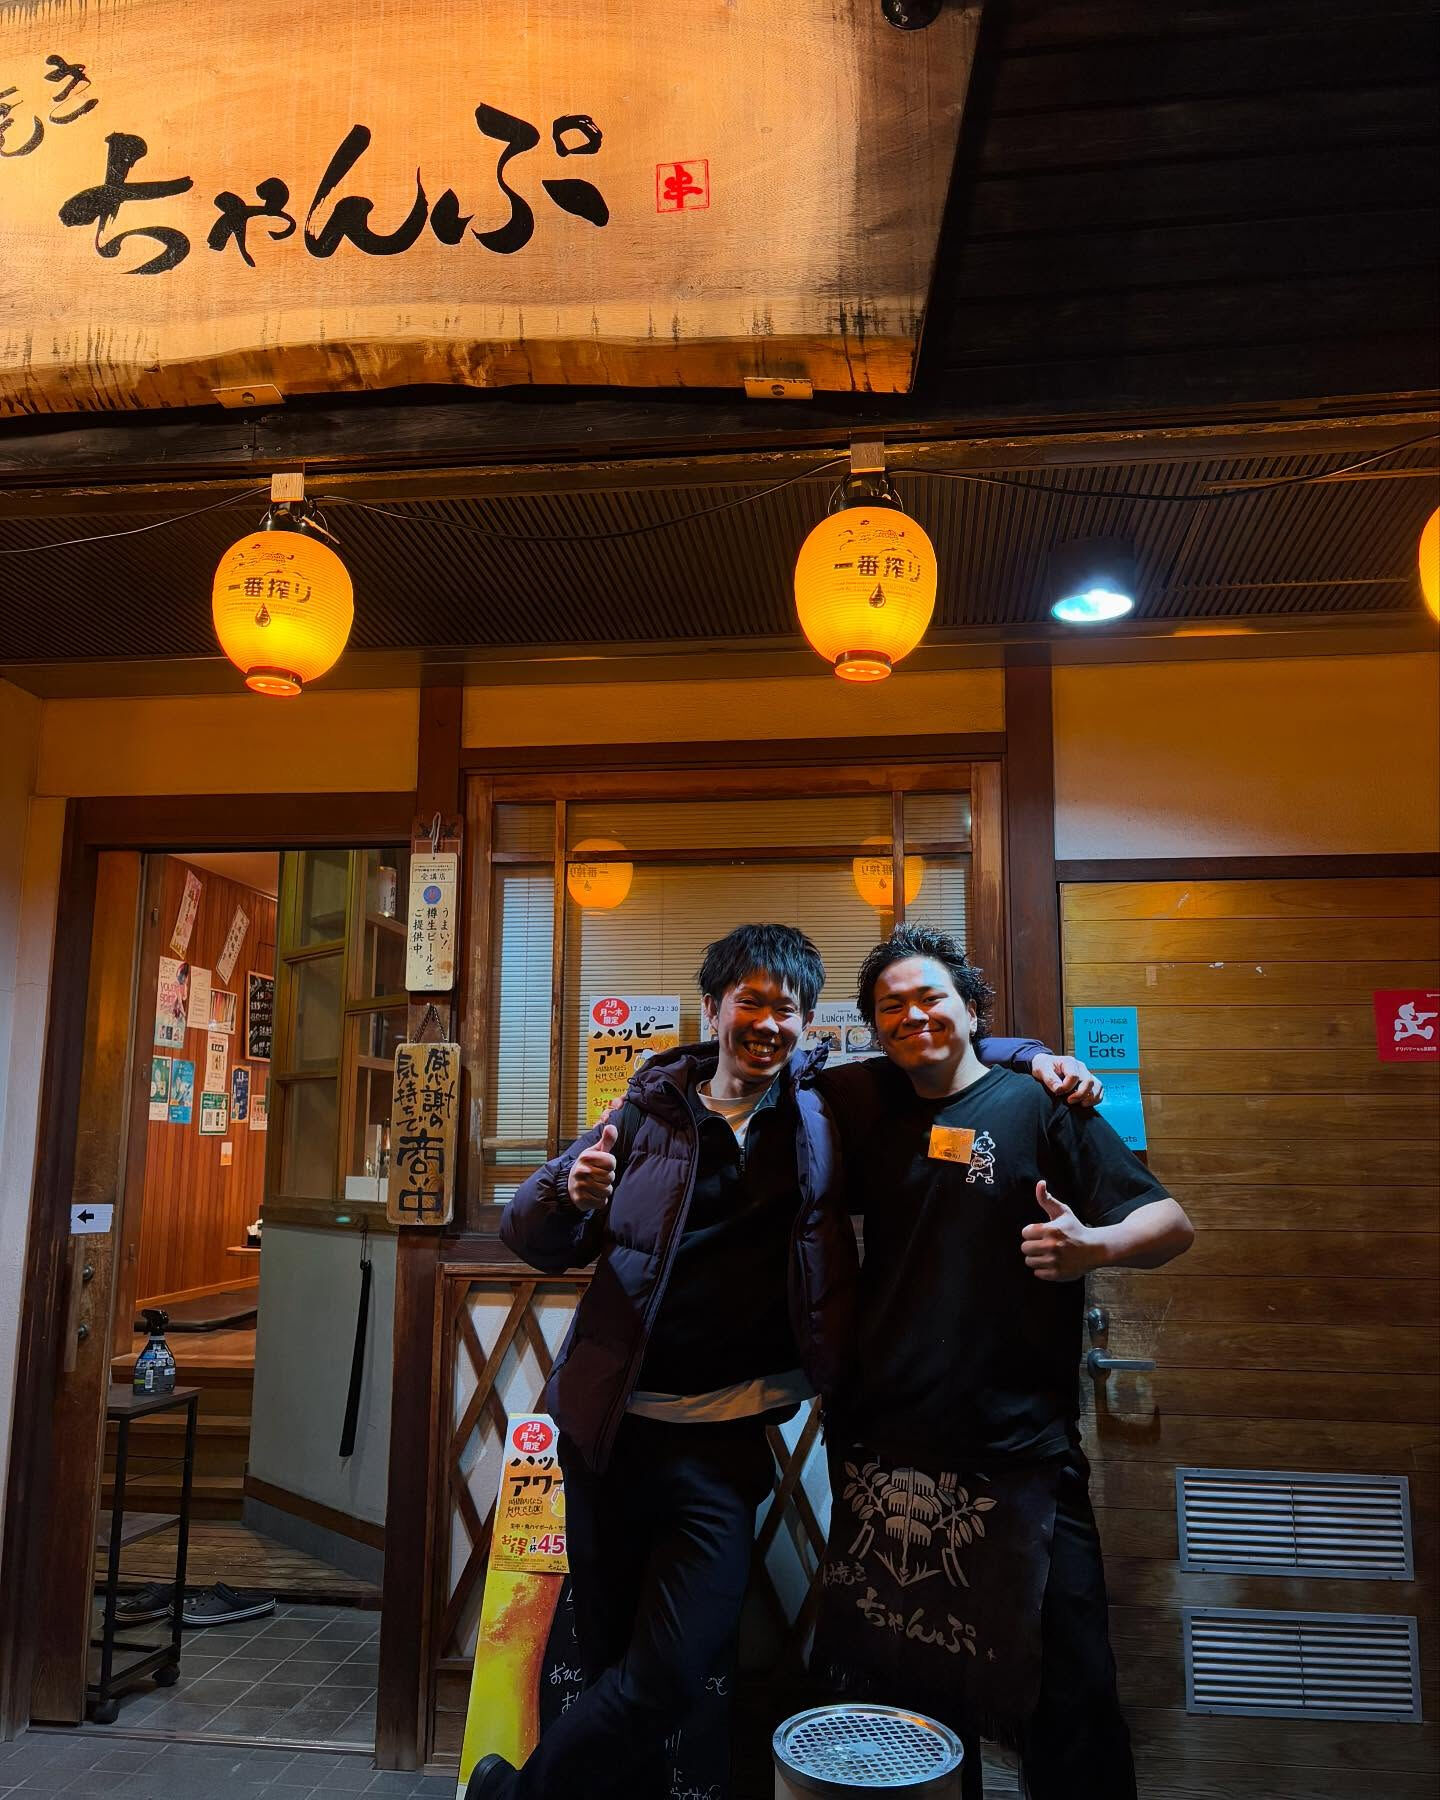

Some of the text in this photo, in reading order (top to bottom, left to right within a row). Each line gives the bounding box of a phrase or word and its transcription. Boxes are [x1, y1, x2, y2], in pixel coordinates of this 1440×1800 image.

[59, 102, 610, 275] ちゃんぷ
[834, 554, 921, 583] 一番搾り
[227, 576, 312, 604] 一番搾り
[425, 907, 438, 976] 樽生ビールを
[605, 1000, 618, 1008] 2月
[593, 1016, 674, 1042] ハッピー
[603, 1017, 619, 1025] 限定
[1088, 1031, 1125, 1044] Uber
[594, 1045, 653, 1065] アワー
[1089, 1046, 1126, 1058] Eats
[394, 1053, 427, 1132] 気持ちで
[420, 1047, 455, 1130] 感謝の
[396, 1127, 445, 1219] 商い中
[527, 1424, 540, 1432] 2月
[523, 1442, 540, 1451] 限定
[855, 1586, 977, 1657] ちゃんぷ
